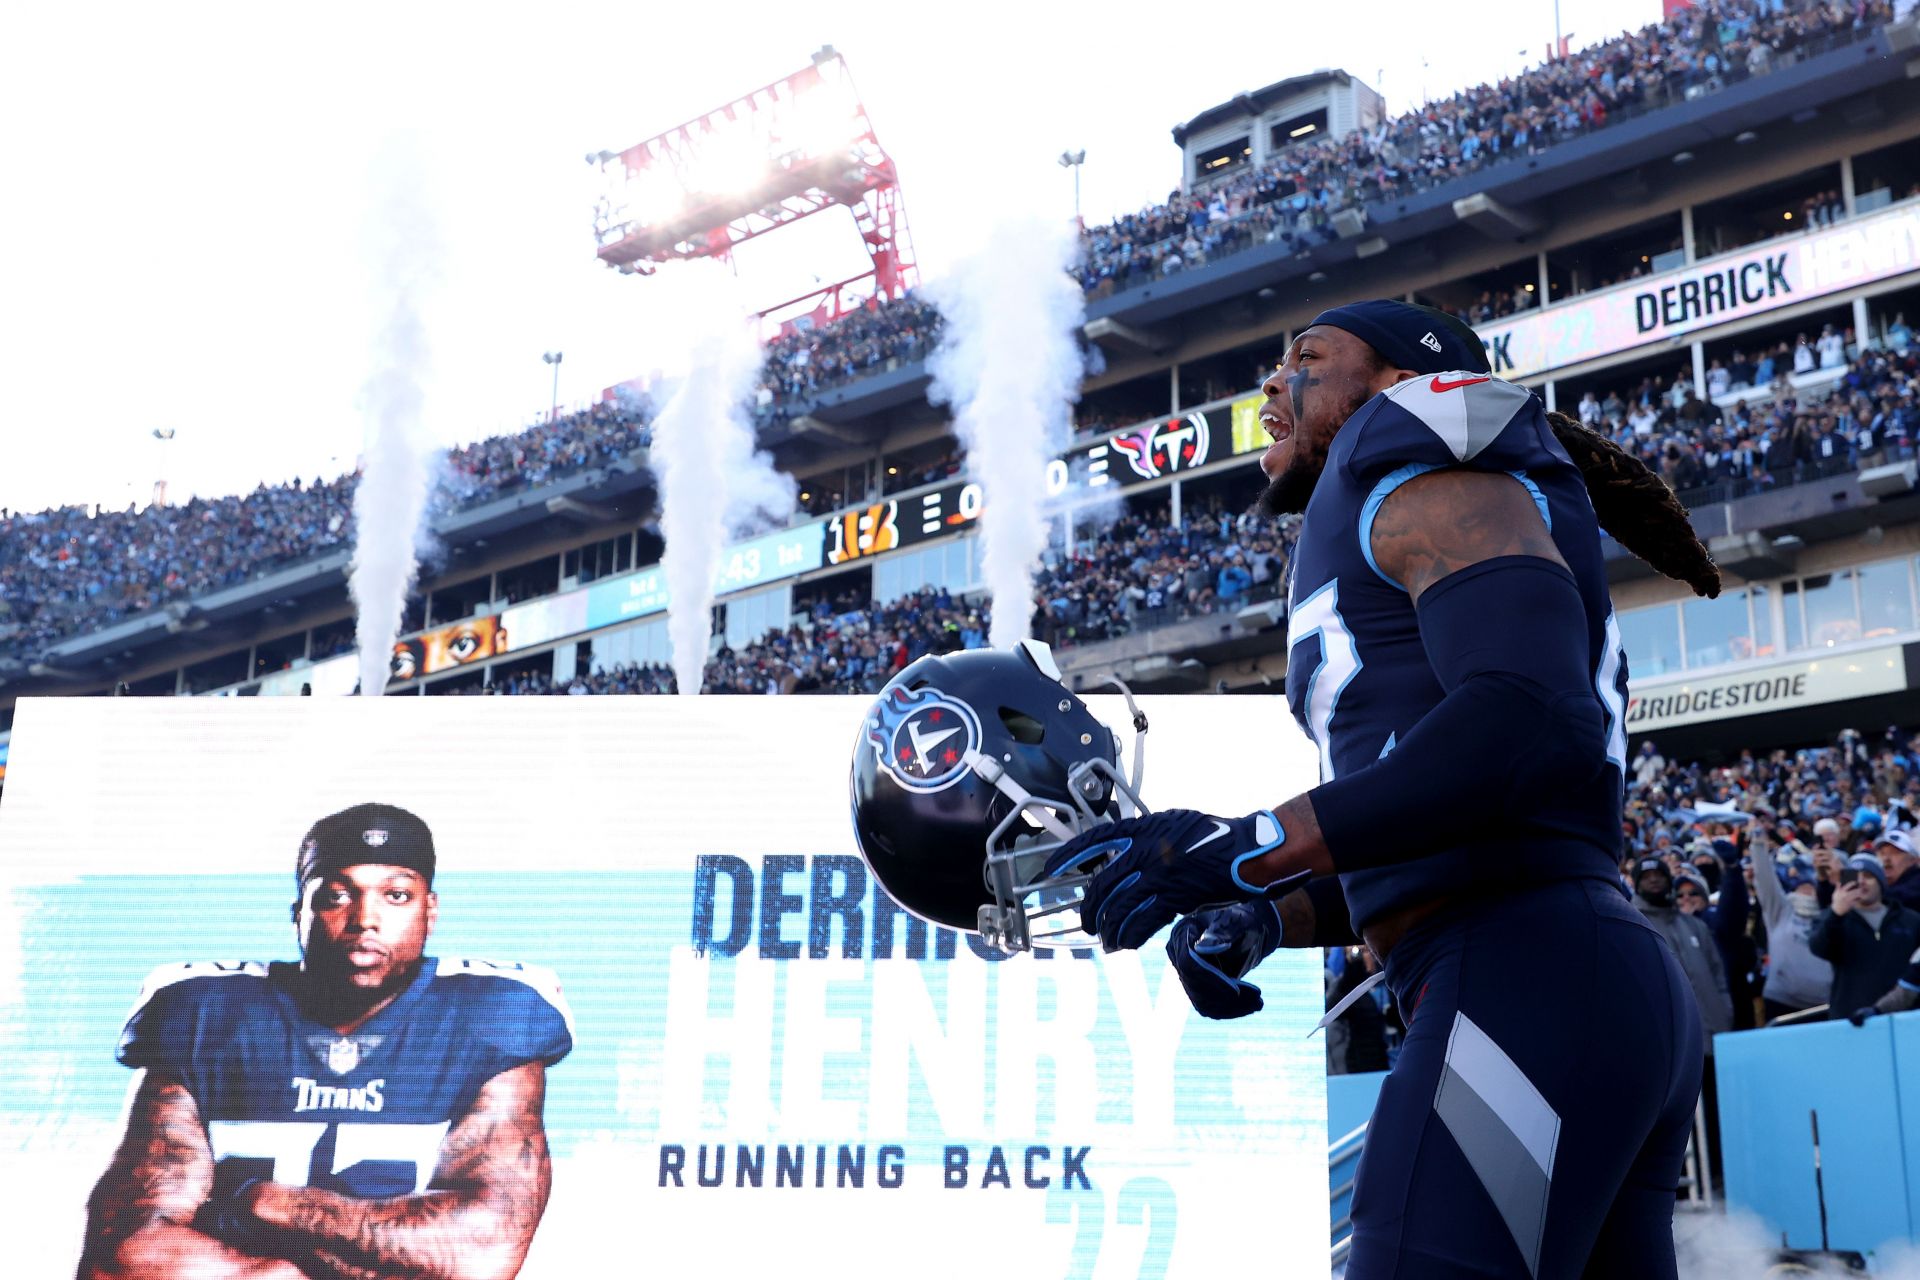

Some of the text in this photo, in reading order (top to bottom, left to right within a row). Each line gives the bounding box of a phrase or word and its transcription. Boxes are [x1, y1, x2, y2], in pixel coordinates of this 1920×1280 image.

[1636, 253, 1792, 334] DERRICK
[1628, 674, 1807, 722] BRIDGESTONE
[658, 945, 1198, 1143] HENRY
[657, 1144, 1093, 1190] RUNNING BACK
